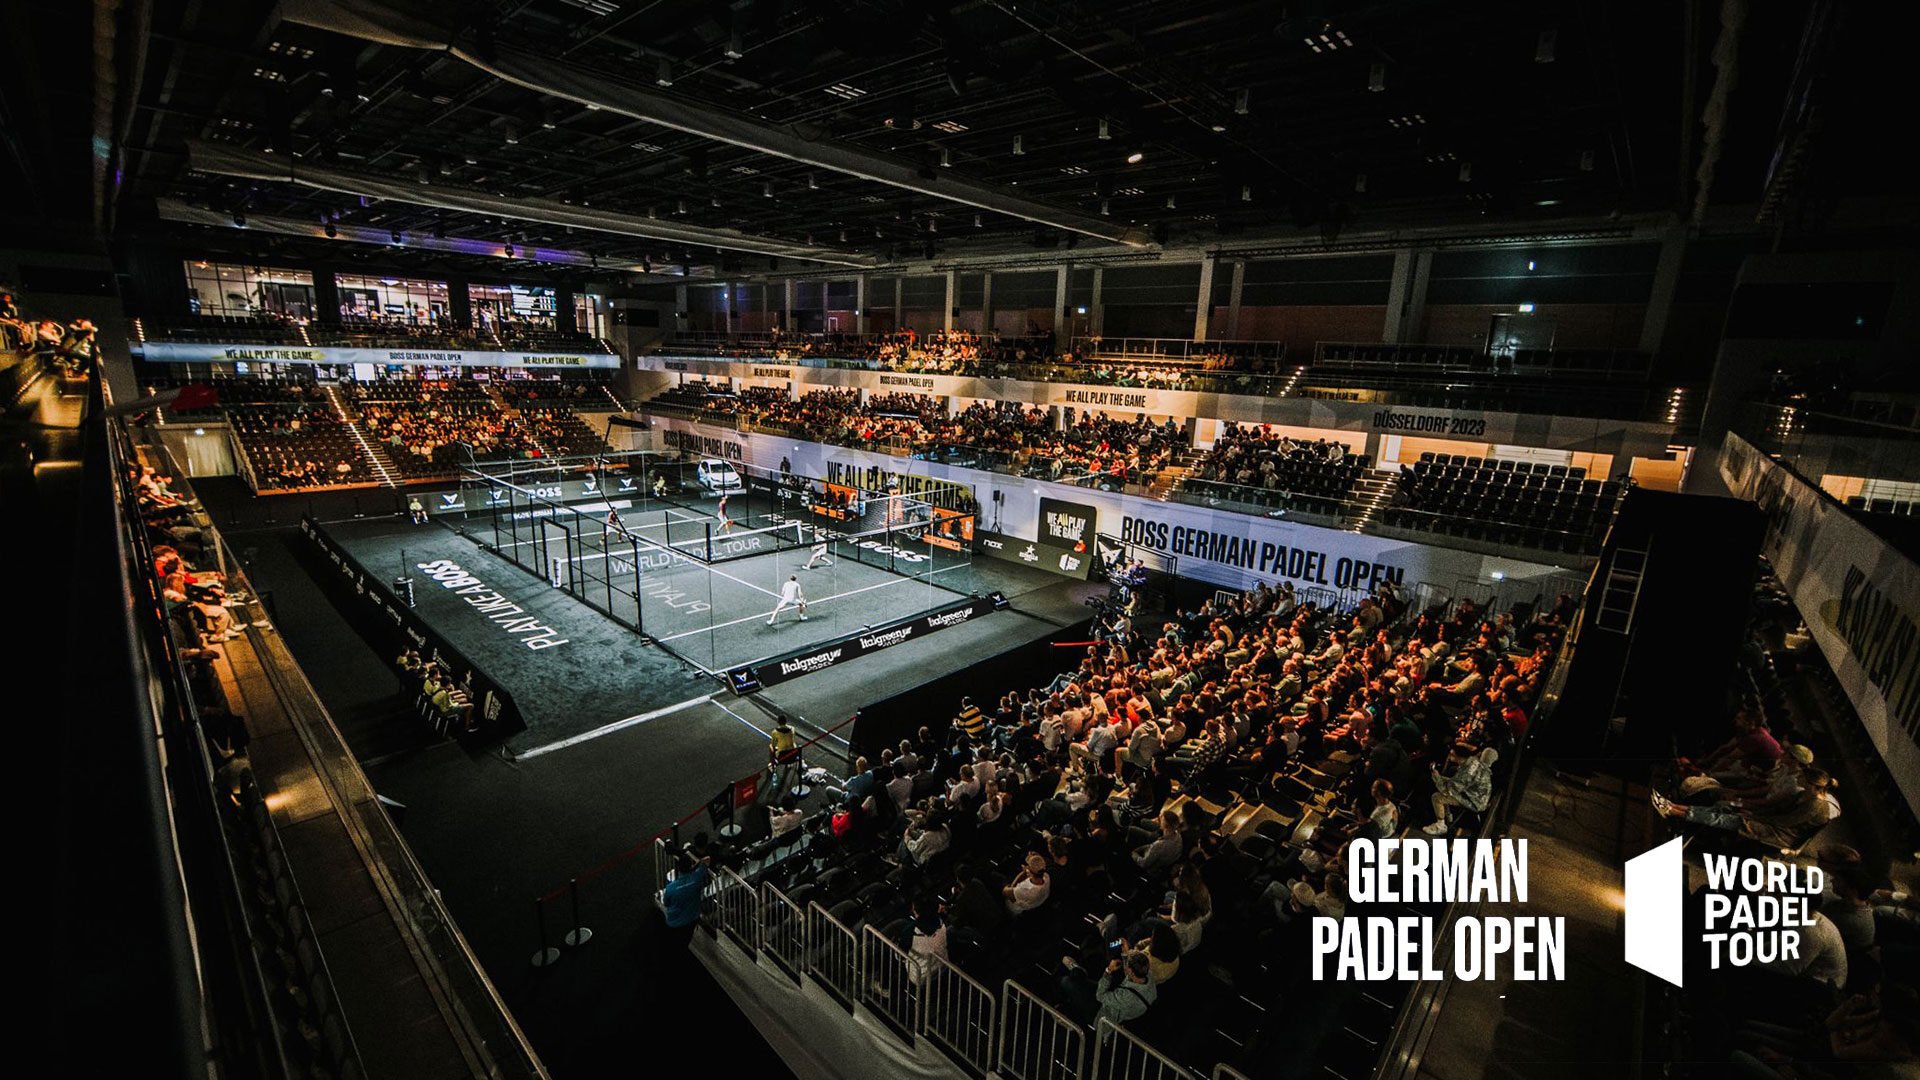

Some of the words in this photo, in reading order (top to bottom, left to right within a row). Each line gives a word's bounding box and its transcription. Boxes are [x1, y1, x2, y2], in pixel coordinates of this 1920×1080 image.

[225, 349, 238, 359] WE
[240, 349, 254, 360] ALL
[254, 350, 274, 360] PLAY
[275, 350, 290, 360] THE
[292, 351, 314, 361] GAME
[389, 352, 405, 360] BOSS
[405, 352, 429, 361] GERMAN
[430, 353, 446, 361] PADEL
[1066, 390, 1077, 402] WE
[1077, 391, 1089, 404] ALL
[1090, 391, 1109, 405] PLAY
[1109, 392, 1124, 407] THE
[1124, 394, 1147, 408] GAME
[1373, 409, 1451, 434] DÜSSELDORF
[1449, 417, 1487, 437] 2023
[704, 436, 723, 457] PADEL
[723, 440, 742, 460] OPEN
[827, 460, 843, 484] WE
[845, 464, 865, 490] ALL
[1047, 511, 1058, 525] WE
[1068, 515, 1087, 531] PLAY
[1049, 524, 1062, 538] THE
[1062, 526, 1083, 541] GAME
[722, 536, 762, 556] TOUR
[1121, 515, 1169, 551] BOSS
[1171, 525, 1255, 570] GERMAN
[1259, 541, 1329, 586] PADEL
[1333, 556, 1405, 596] OPEN
[416, 559, 482, 589] BOSS
[454, 583, 494, 595] A
[463, 591, 525, 619] LIKE
[927, 607, 974, 628] Italgreen
[494, 615, 570, 651] PLAY
[860, 626, 913, 650] Italgreen
[780, 648, 842, 676] Italgreen
